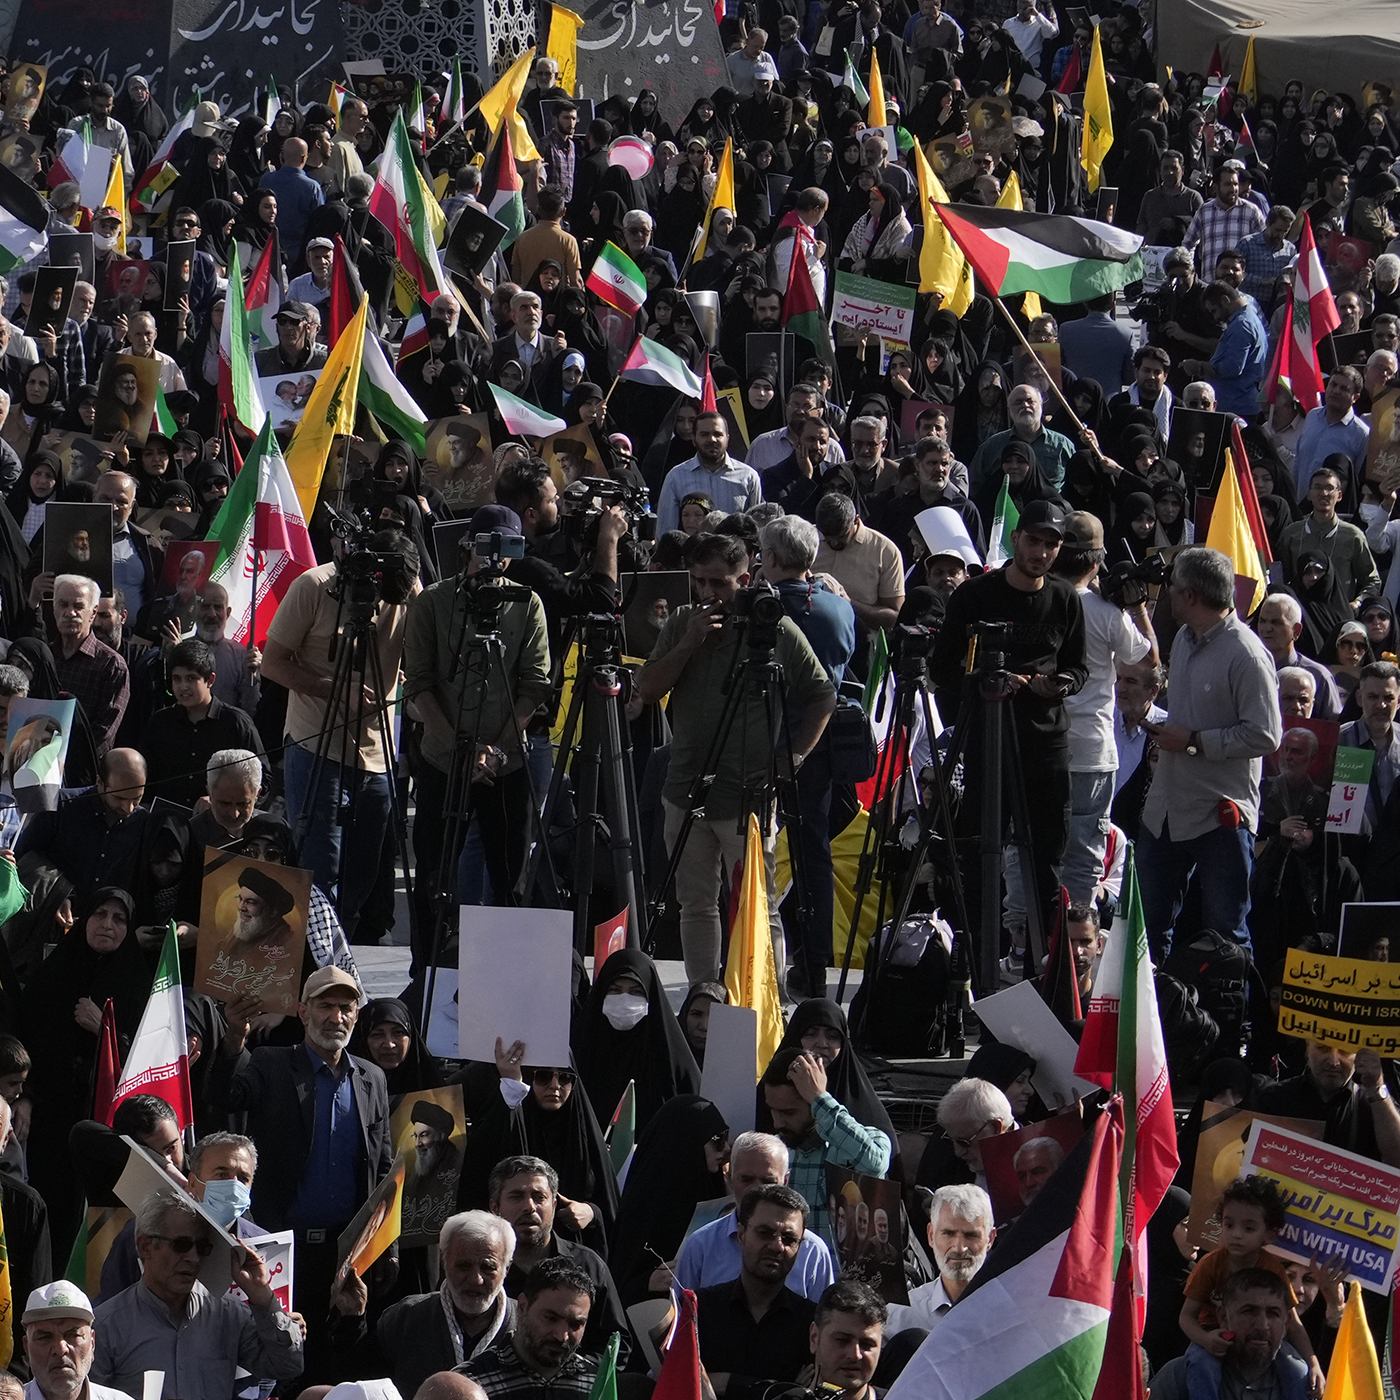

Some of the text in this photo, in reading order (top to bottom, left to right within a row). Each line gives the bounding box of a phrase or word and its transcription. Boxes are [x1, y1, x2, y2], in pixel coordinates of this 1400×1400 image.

[841, 301, 906, 319] تا آخر
[1343, 785, 1357, 802] تا
[1290, 961, 1357, 988] اسرائیل
[1362, 978, 1380, 995] بر
[1283, 990, 1400, 1018] DOWN WITH ISR
[1261, 1139, 1288, 1154] فلسطین
[1288, 1147, 1297, 1156] در
[1297, 1151, 1314, 1162] امروز
[1308, 1169, 1327, 1180] جرم
[1319, 1203, 1396, 1240] مرگ بر
[1303, 1230, 1349, 1259] WITH
[1351, 1243, 1385, 1273] USA
